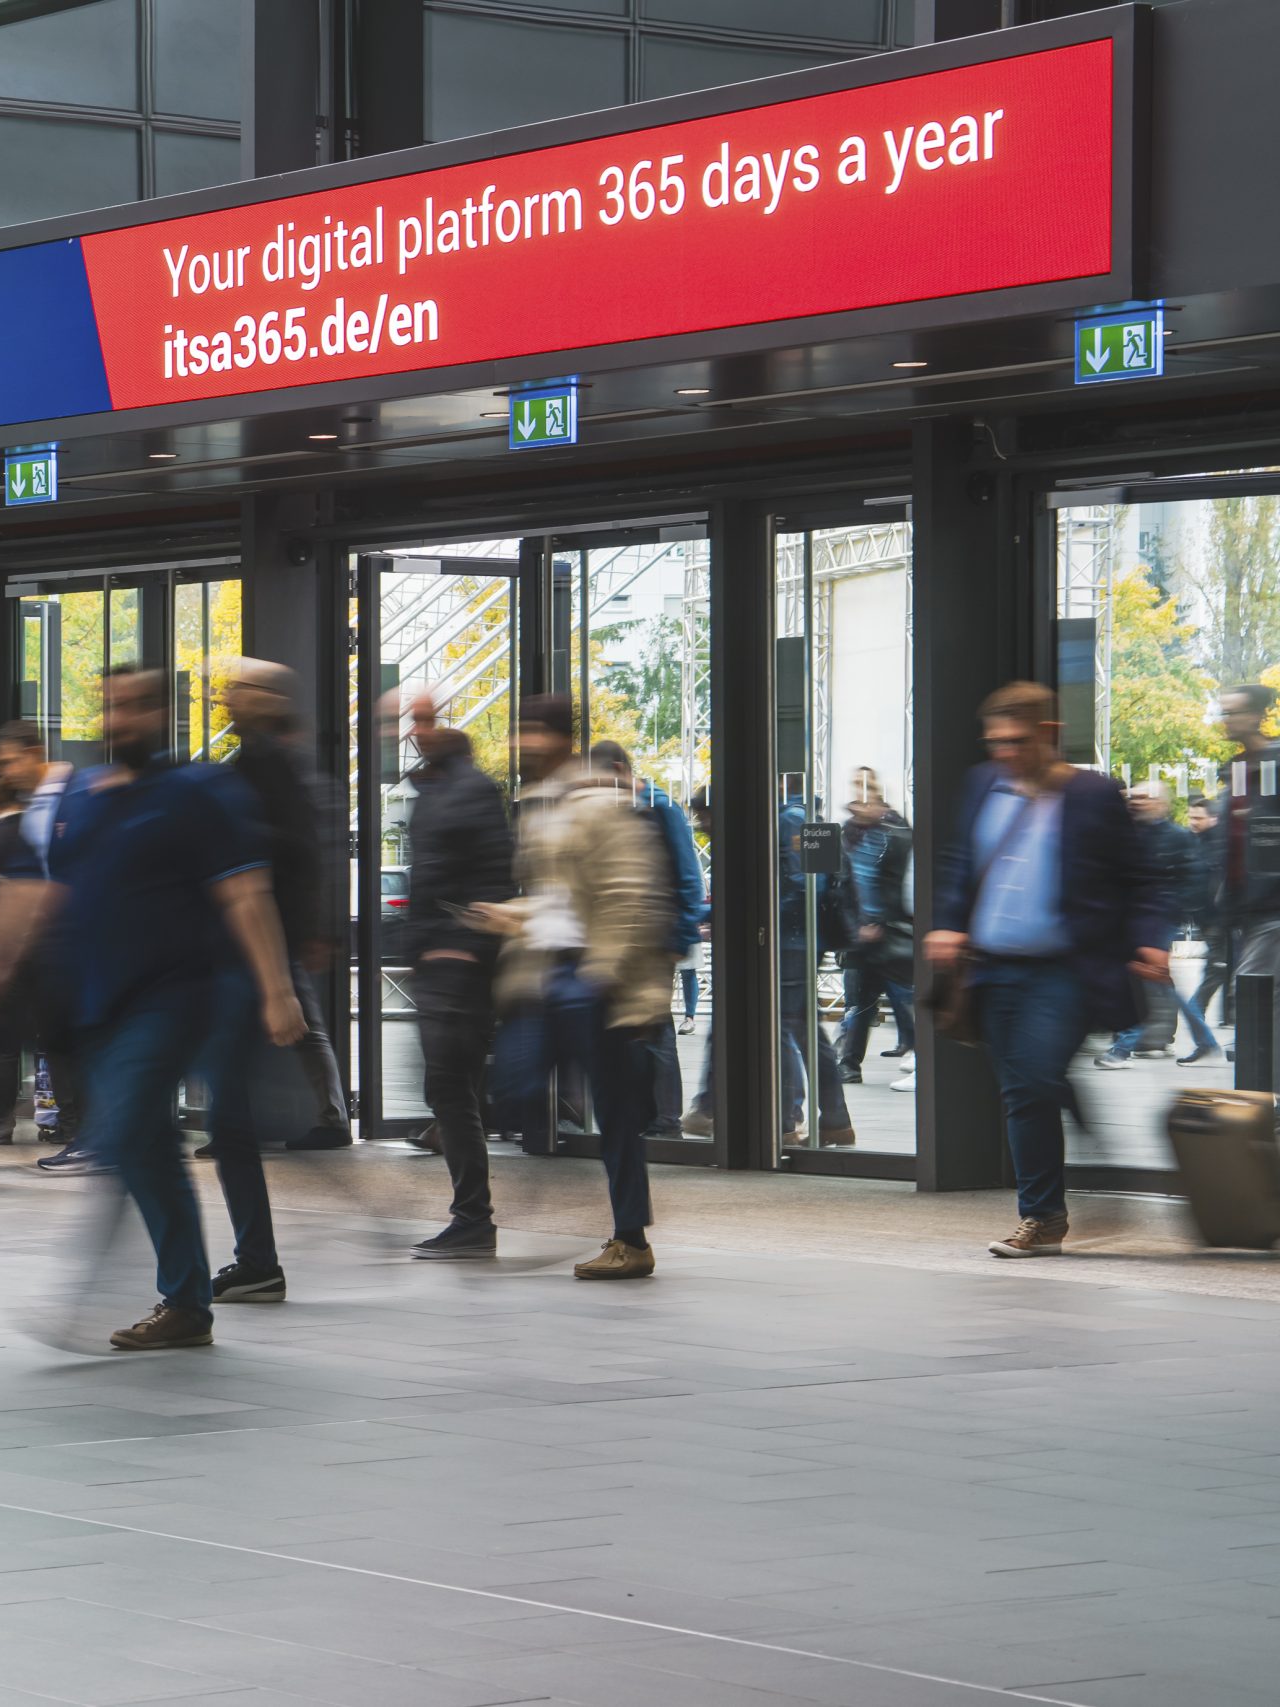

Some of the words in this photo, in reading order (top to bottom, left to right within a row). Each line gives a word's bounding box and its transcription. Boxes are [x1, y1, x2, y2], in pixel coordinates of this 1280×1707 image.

[162, 244, 251, 298] Your
[261, 206, 384, 291] digital
[398, 184, 583, 275] platform
[598, 154, 685, 226] 365
[701, 141, 821, 215] days
[837, 136, 867, 185] a
[882, 109, 1004, 195] year
[163, 293, 439, 379] itsa365.de/en
[803, 840, 820, 849] Push
